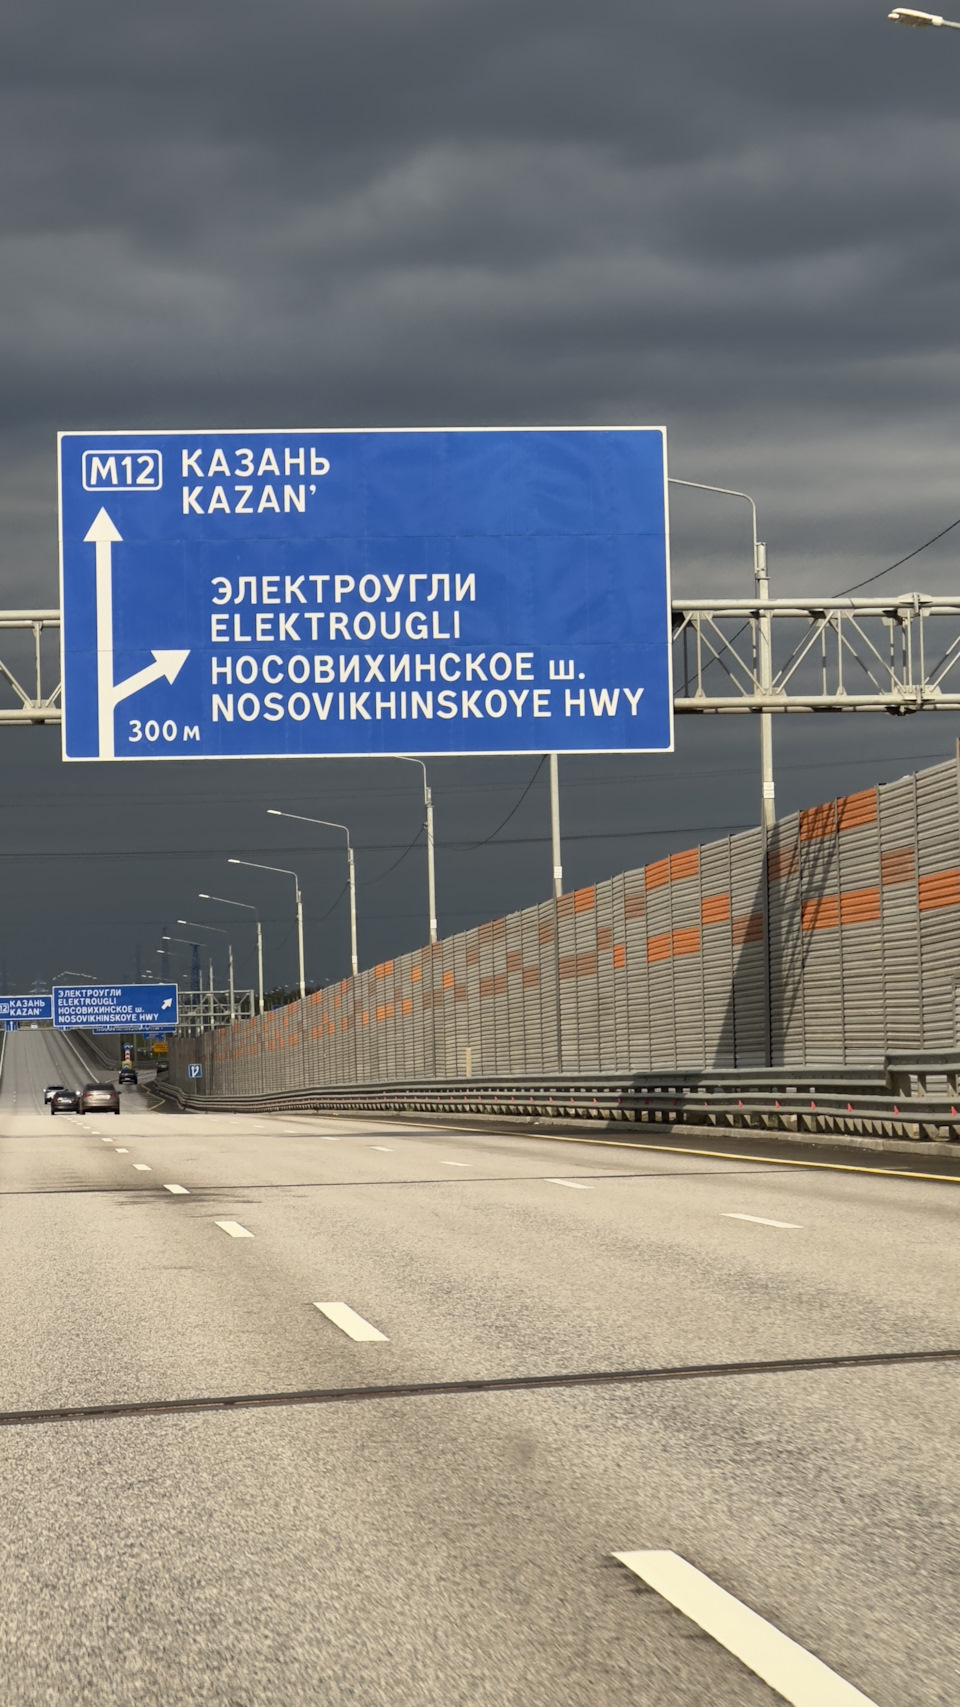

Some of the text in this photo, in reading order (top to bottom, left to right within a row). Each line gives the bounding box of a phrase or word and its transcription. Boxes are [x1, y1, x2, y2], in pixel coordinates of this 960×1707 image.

[182, 448, 330, 477] КАЗАНЬ
[183, 485, 316, 514] KAZAN'
[212, 573, 476, 604] ЭЛЕКТРОУГЛИ
[211, 611, 460, 642] ELEKTROUGLI
[212, 652, 585, 685] НОСОВИХИНСКОЕ ш.
[212, 688, 645, 722] NOSOVIKHINSKOYE HWY
[129, 720, 201, 742] 300 м
[9, 999, 46, 1008] КАЗАНЬ
[58, 989, 122, 998] ЭЛЕКТРОУГЛИ
[58, 998, 117, 1006] ELEKTROUGLI
[58, 1006, 133, 1015] НОСОВИХИНСКОЕ
[58, 1013, 159, 1023] NOSOVIKHINSKOYE HWY
